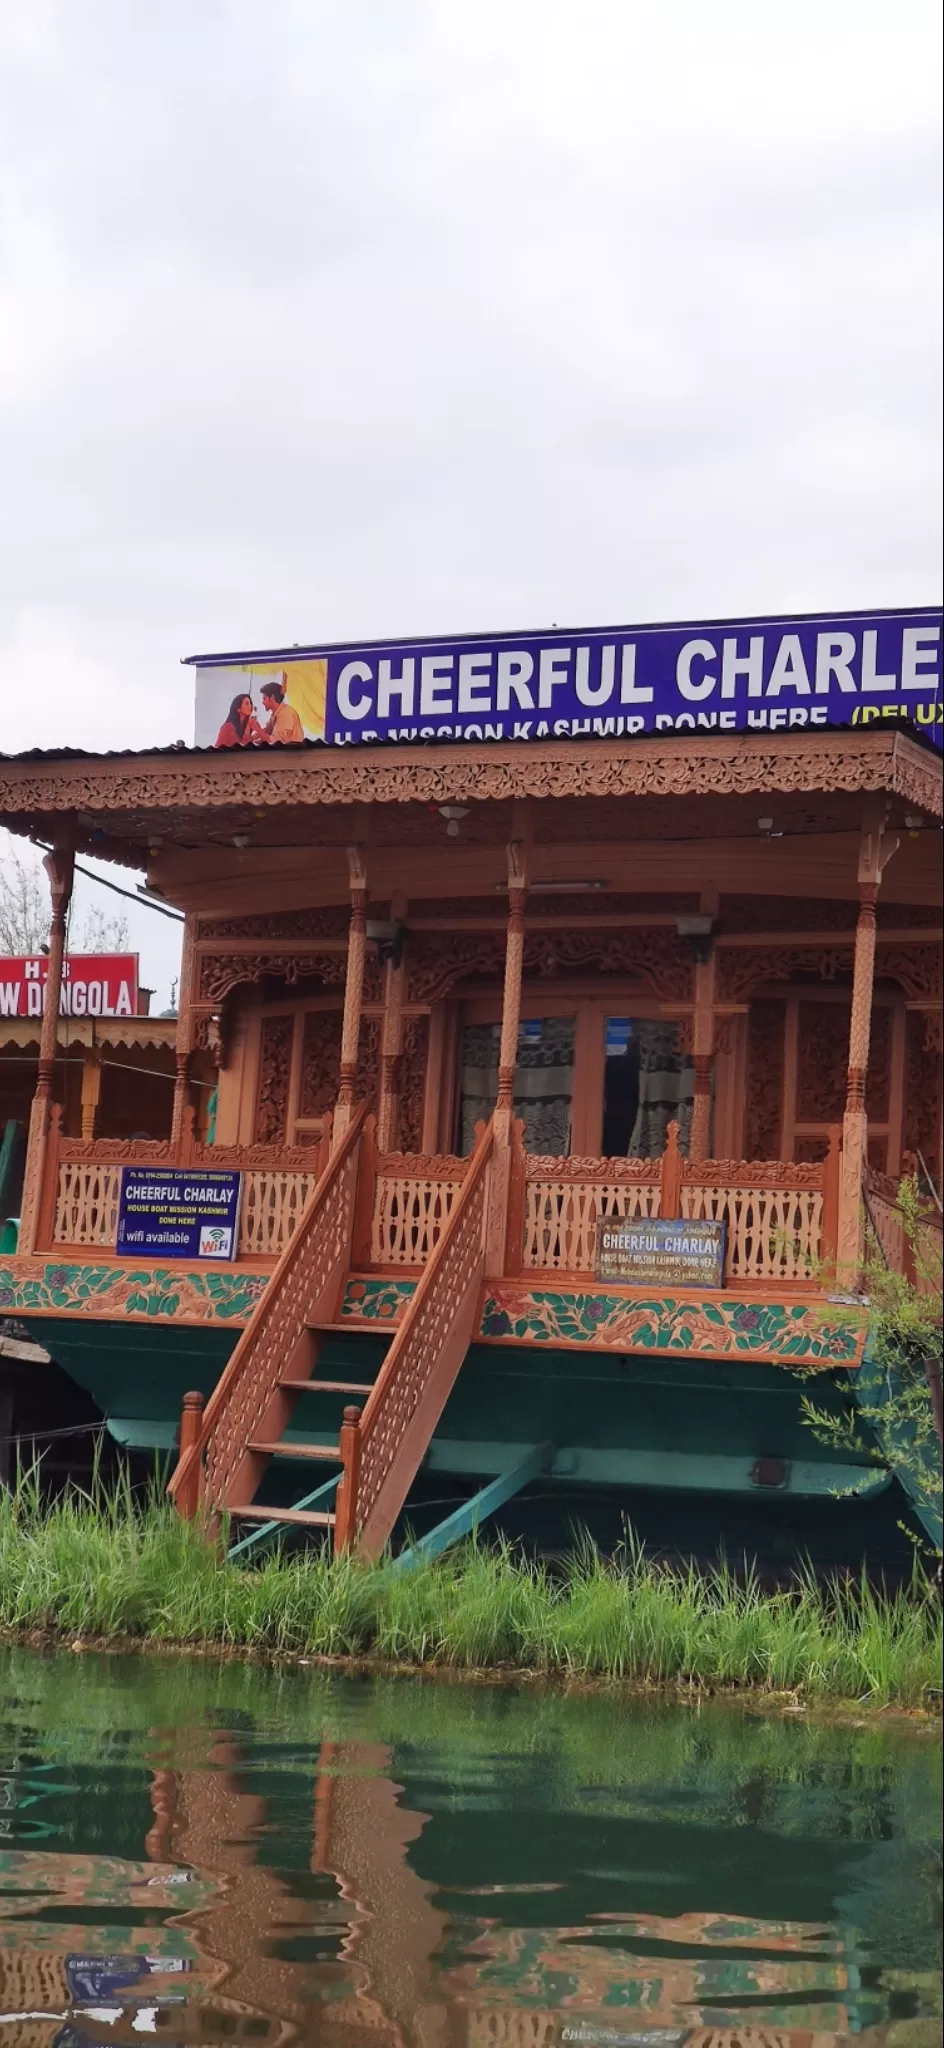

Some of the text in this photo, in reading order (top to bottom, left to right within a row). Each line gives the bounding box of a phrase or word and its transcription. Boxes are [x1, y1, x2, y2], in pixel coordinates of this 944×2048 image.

[336, 627, 940, 720] CHEERFUL CHARLE
[513, 716, 645, 740] KASHMIR
[655, 711, 737, 730] DONE
[747, 706, 828, 730] HERE
[28, 980, 132, 1018] DNGOLA
[126, 1185, 234, 1203] CHEERFUL CHARLAY
[127, 1204, 229, 1215] HOUSE BOAT MISSION KASHMIR
[126, 1231, 190, 1243] wifi available
[603, 1233, 719, 1254] CHEERFUL CHARLAY
[633, 1255, 655, 1264] MISSION
[682, 1258, 700, 1267] DONE
